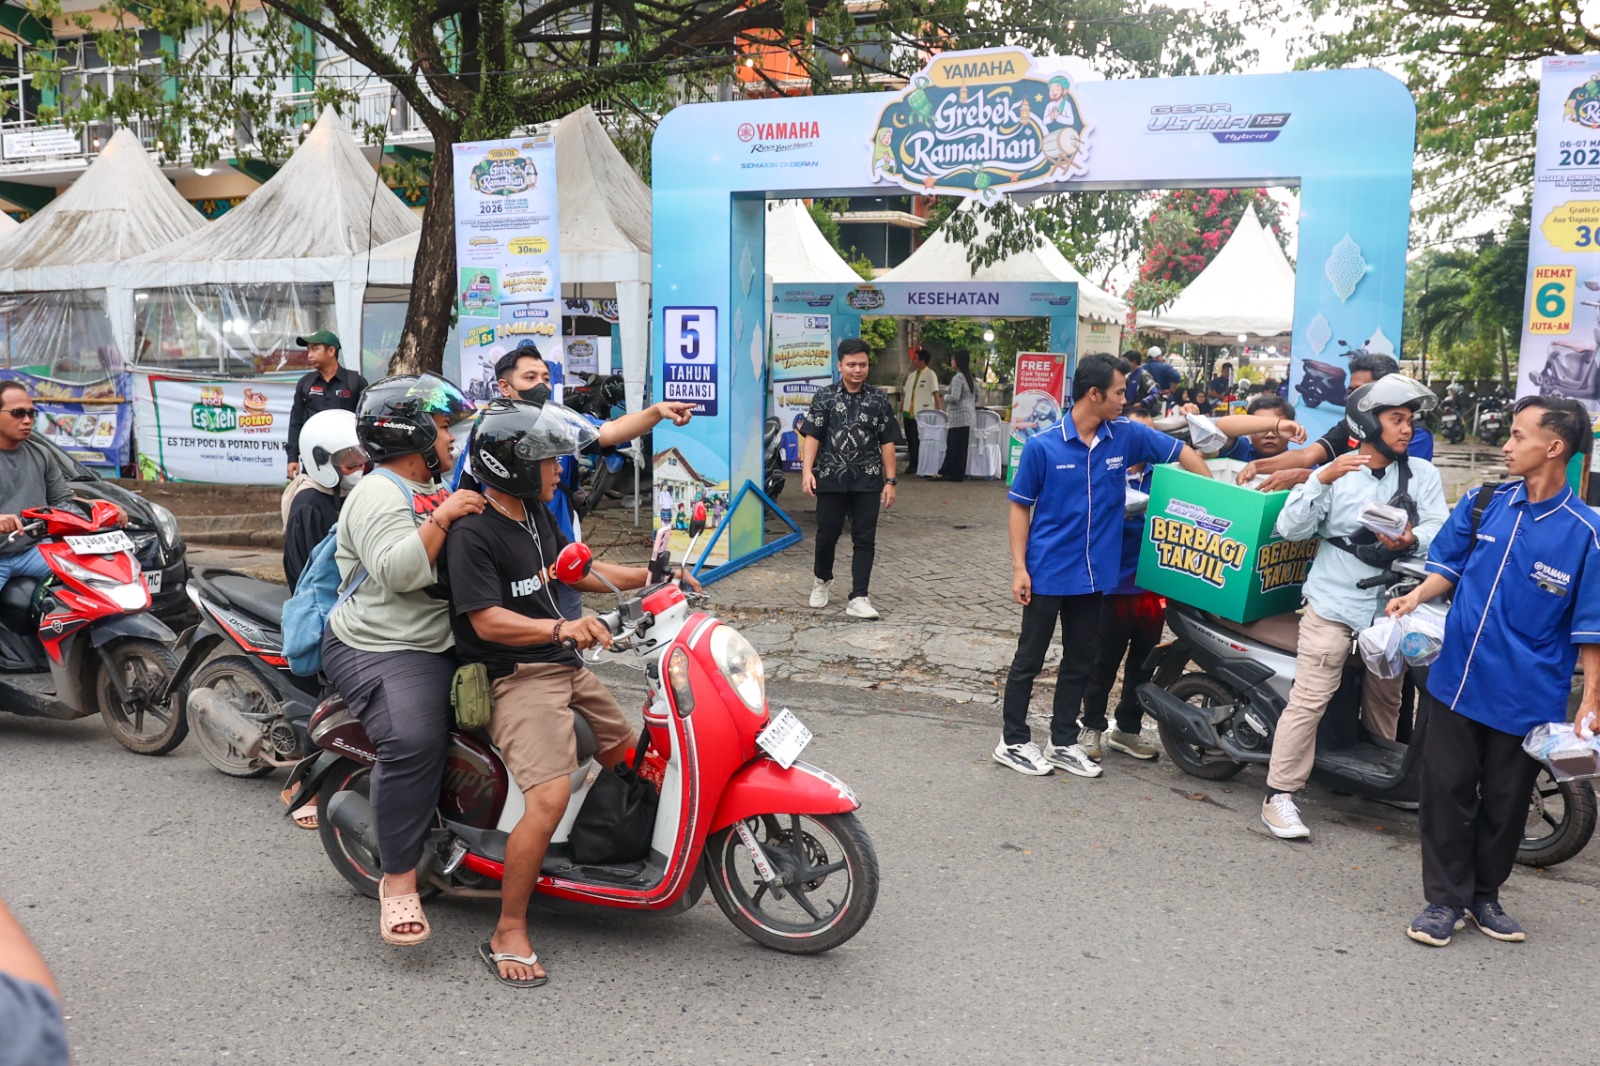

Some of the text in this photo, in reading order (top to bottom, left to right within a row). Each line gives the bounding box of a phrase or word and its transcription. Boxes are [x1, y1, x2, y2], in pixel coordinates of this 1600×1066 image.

[943, 60, 1015, 80] YAMAHA
[1151, 103, 1231, 115] GEAR
[1147, 114, 1284, 131] ULTIMA 125
[756, 121, 820, 140] YAMAHA
[1224, 133, 1269, 141] Hybrid
[775, 143, 793, 152] Your
[792, 141, 814, 149] Heart
[906, 124, 1037, 170] Ramadhan
[491, 150, 516, 158] YAMAHA
[480, 204, 503, 214] 2026
[1569, 206, 1590, 215] Gratis
[517, 246, 529, 254] 30
[1536, 269, 1573, 278] HEMAT
[907, 291, 1000, 305] KESEHATAN
[1536, 282, 1566, 318] 6
[808, 318, 813, 327] 5
[1530, 322, 1570, 330] JUTA-AN
[481, 333, 493, 345] 5x
[680, 314, 700, 360] 5
[1021, 360, 1051, 371] FREE
[669, 365, 711, 381] TAHUN
[669, 384, 711, 398] GARANSI
[193, 407, 235, 429] Es Teh
[240, 414, 273, 427] POTATO
[373, 420, 416, 431] evolution
[167, 437, 178, 446] ES
[180, 438, 196, 447] TEH
[197, 439, 217, 448] POCI
[219, 440, 226, 448] &
[228, 440, 260, 450] POTATO
[261, 441, 279, 450] FUN
[242, 455, 273, 464] merchant
[481, 453, 509, 478] INK
[1152, 517, 1247, 569] BERBAGI
[1158, 542, 1225, 587] TAKJIL
[145, 573, 160, 587] MC
[1543, 564, 1571, 583] YAMAHA
[511, 575, 542, 598] HBO
[75, 597, 98, 609] HONDA
[757, 862, 770, 879] BOY
